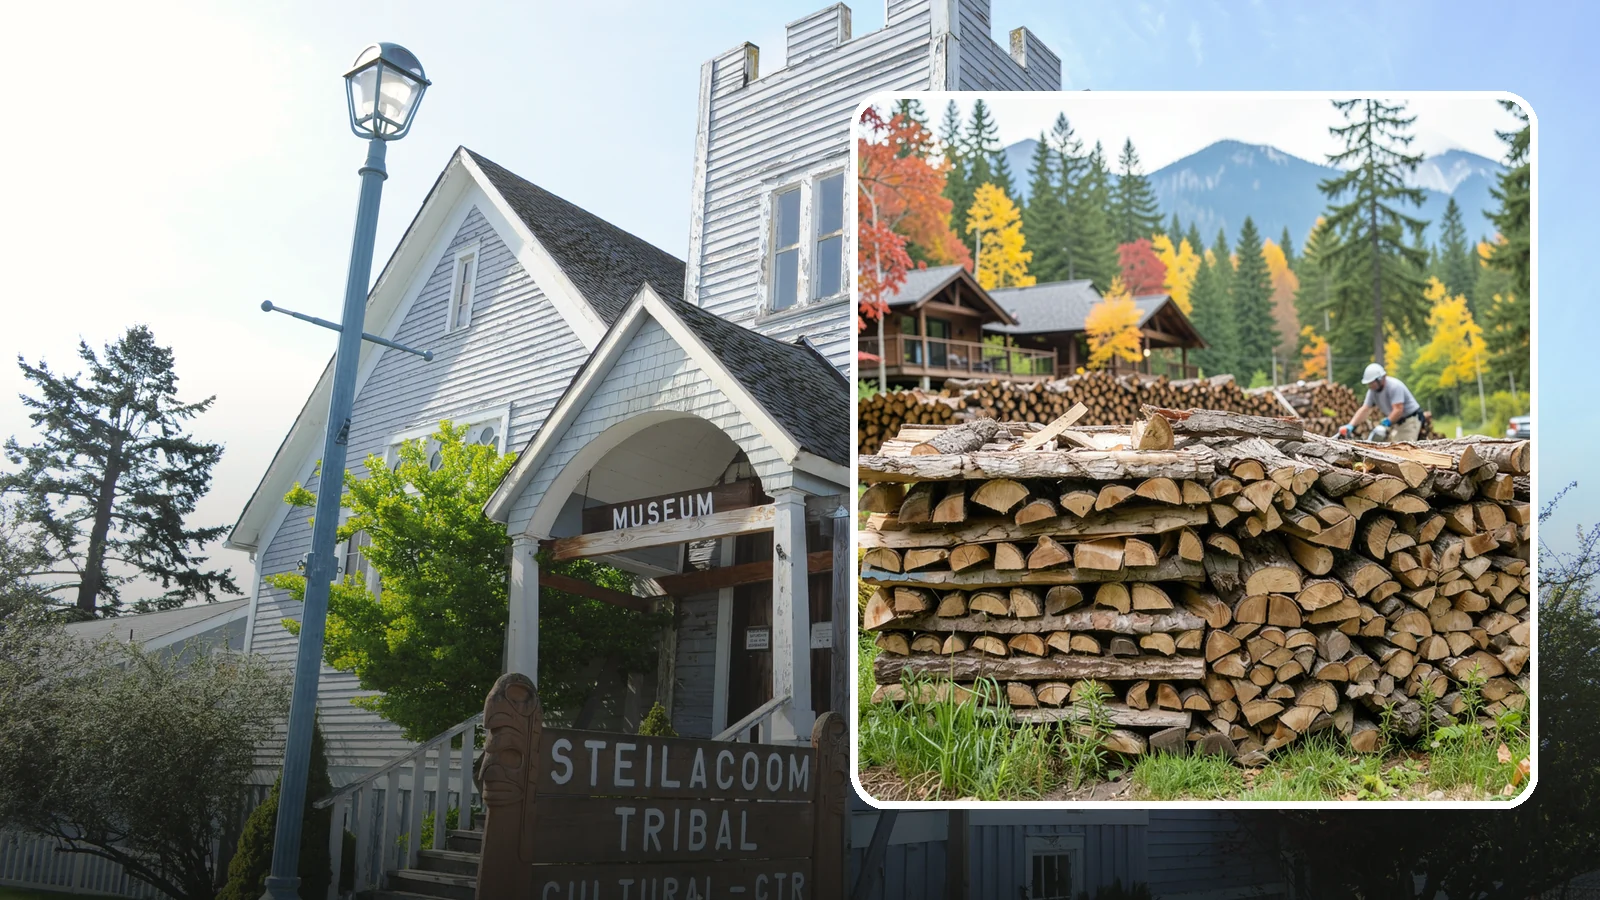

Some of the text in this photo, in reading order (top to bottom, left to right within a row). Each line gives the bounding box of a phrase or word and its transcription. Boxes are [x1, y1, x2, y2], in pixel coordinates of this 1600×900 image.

[612, 491, 714, 530] MUSEUM
[550, 738, 810, 792] STEILACOOM
[614, 806, 758, 852] TRIBAL
[755, 871, 805, 900] CTR
